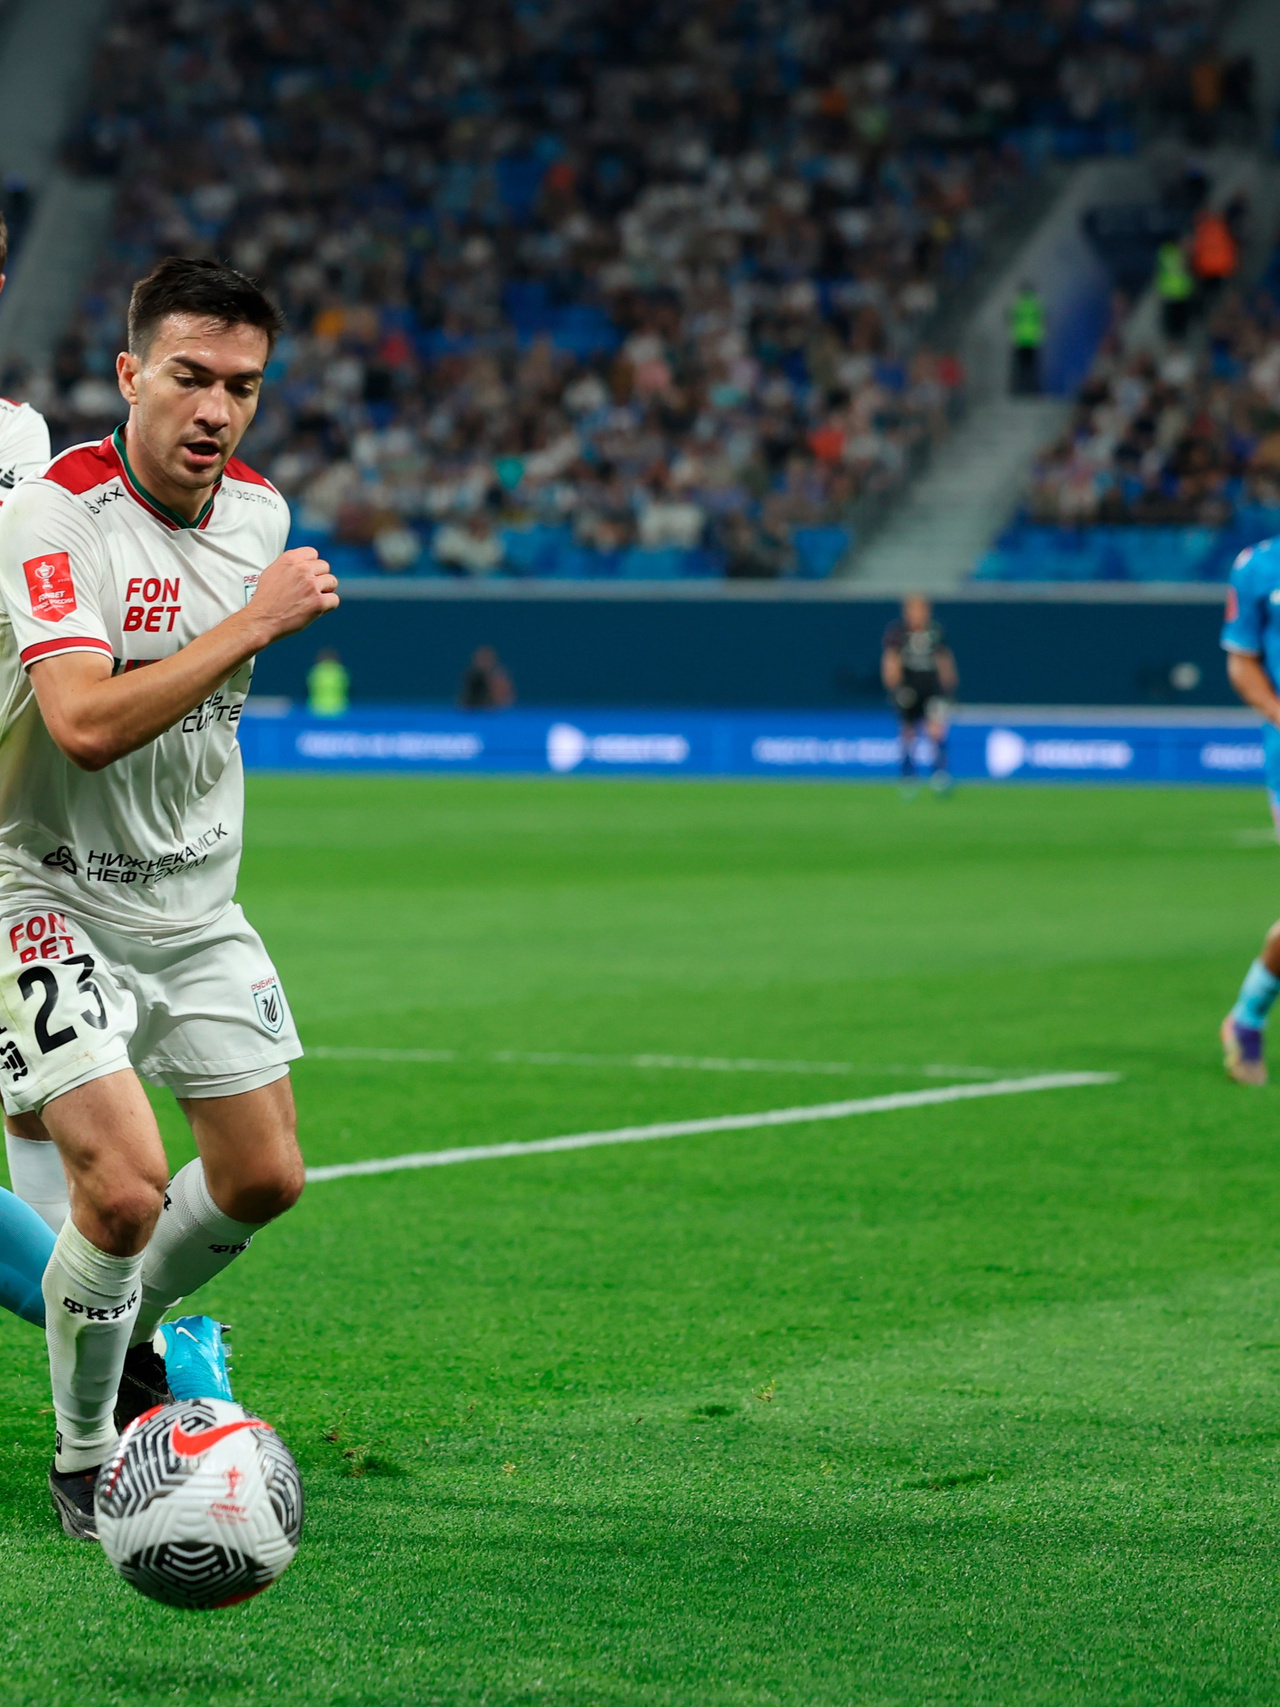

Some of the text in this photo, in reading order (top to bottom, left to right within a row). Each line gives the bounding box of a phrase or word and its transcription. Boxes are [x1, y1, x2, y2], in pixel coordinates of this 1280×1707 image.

[125, 577, 180, 603] FON
[122, 606, 181, 632] BET
[88, 823, 228, 871] НИЖНЕКАМСК
[87, 854, 208, 884] НЕФТЕХИМ
[9, 913, 67, 953] FON
[17, 954, 108, 1055] 23
[62, 1289, 137, 1320] ФКРК
